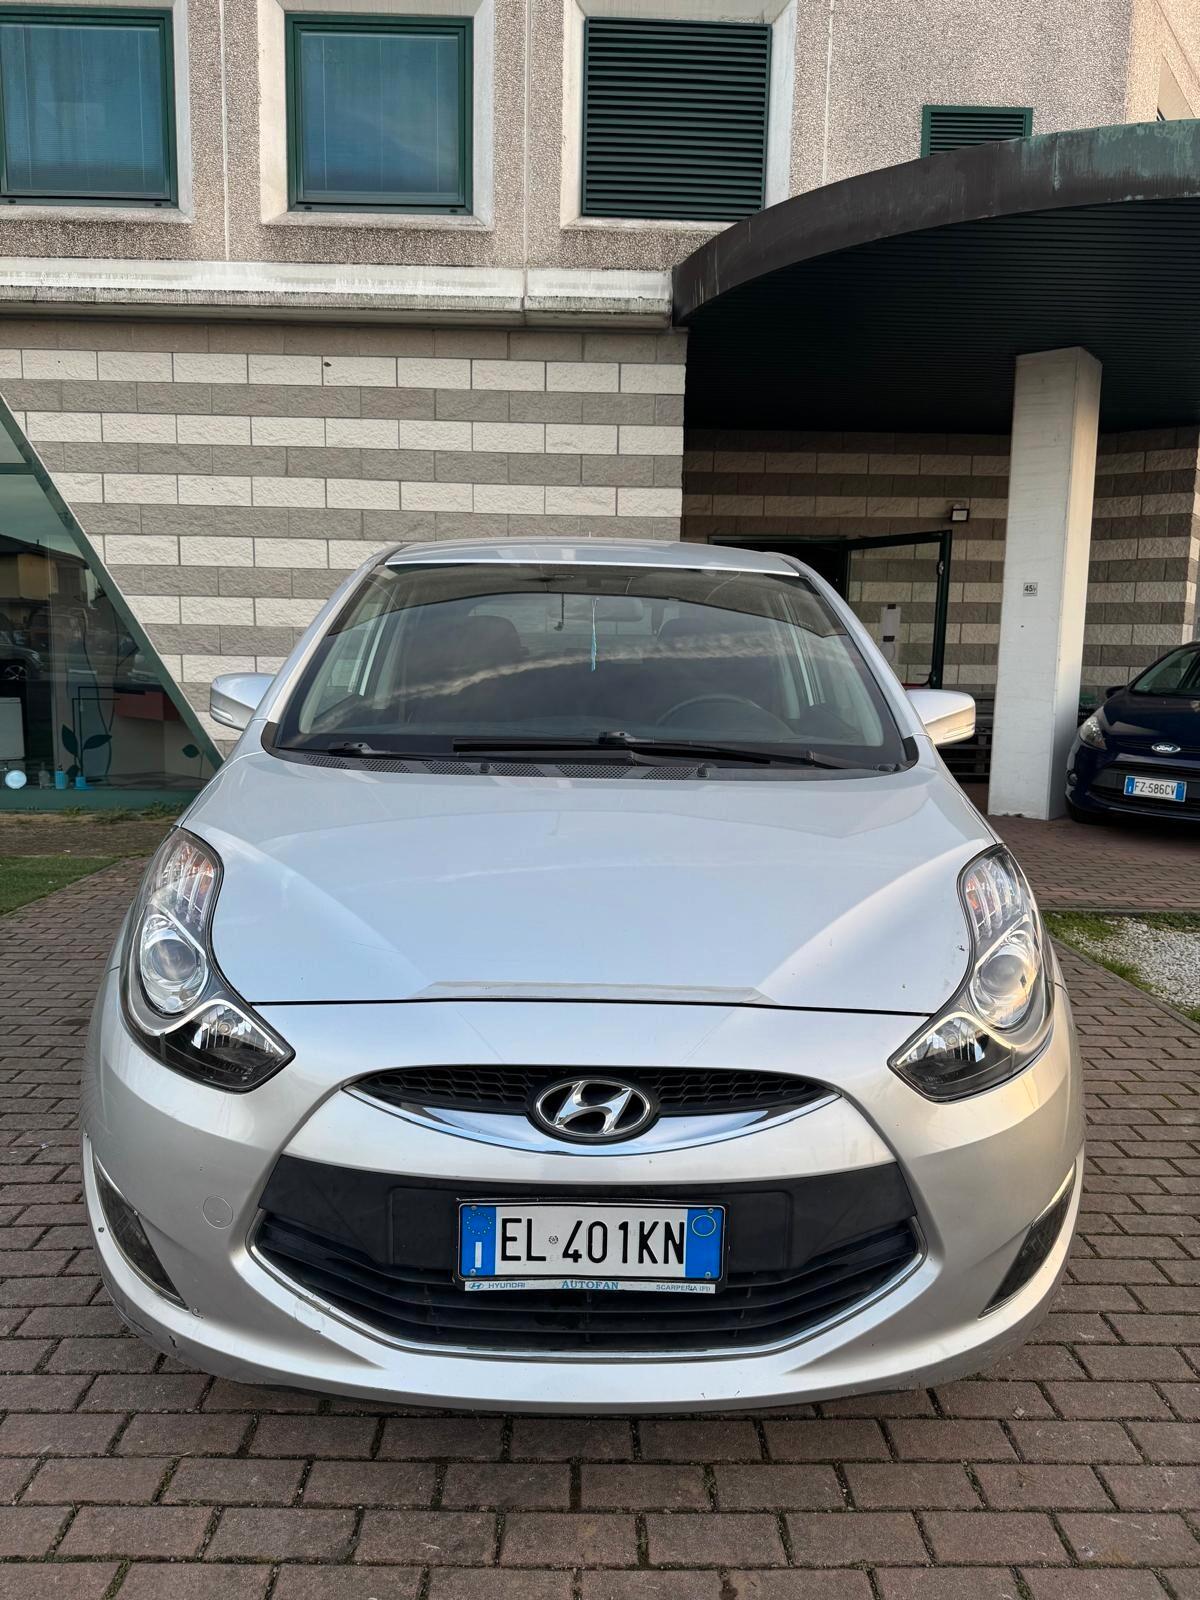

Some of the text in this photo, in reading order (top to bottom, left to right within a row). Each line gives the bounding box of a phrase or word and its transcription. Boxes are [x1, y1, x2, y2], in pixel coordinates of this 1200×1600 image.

[501, 1218, 546, 1261] EL
[562, 1219, 685, 1264] 401KN
[561, 1280, 619, 1290] AUTOFAN
